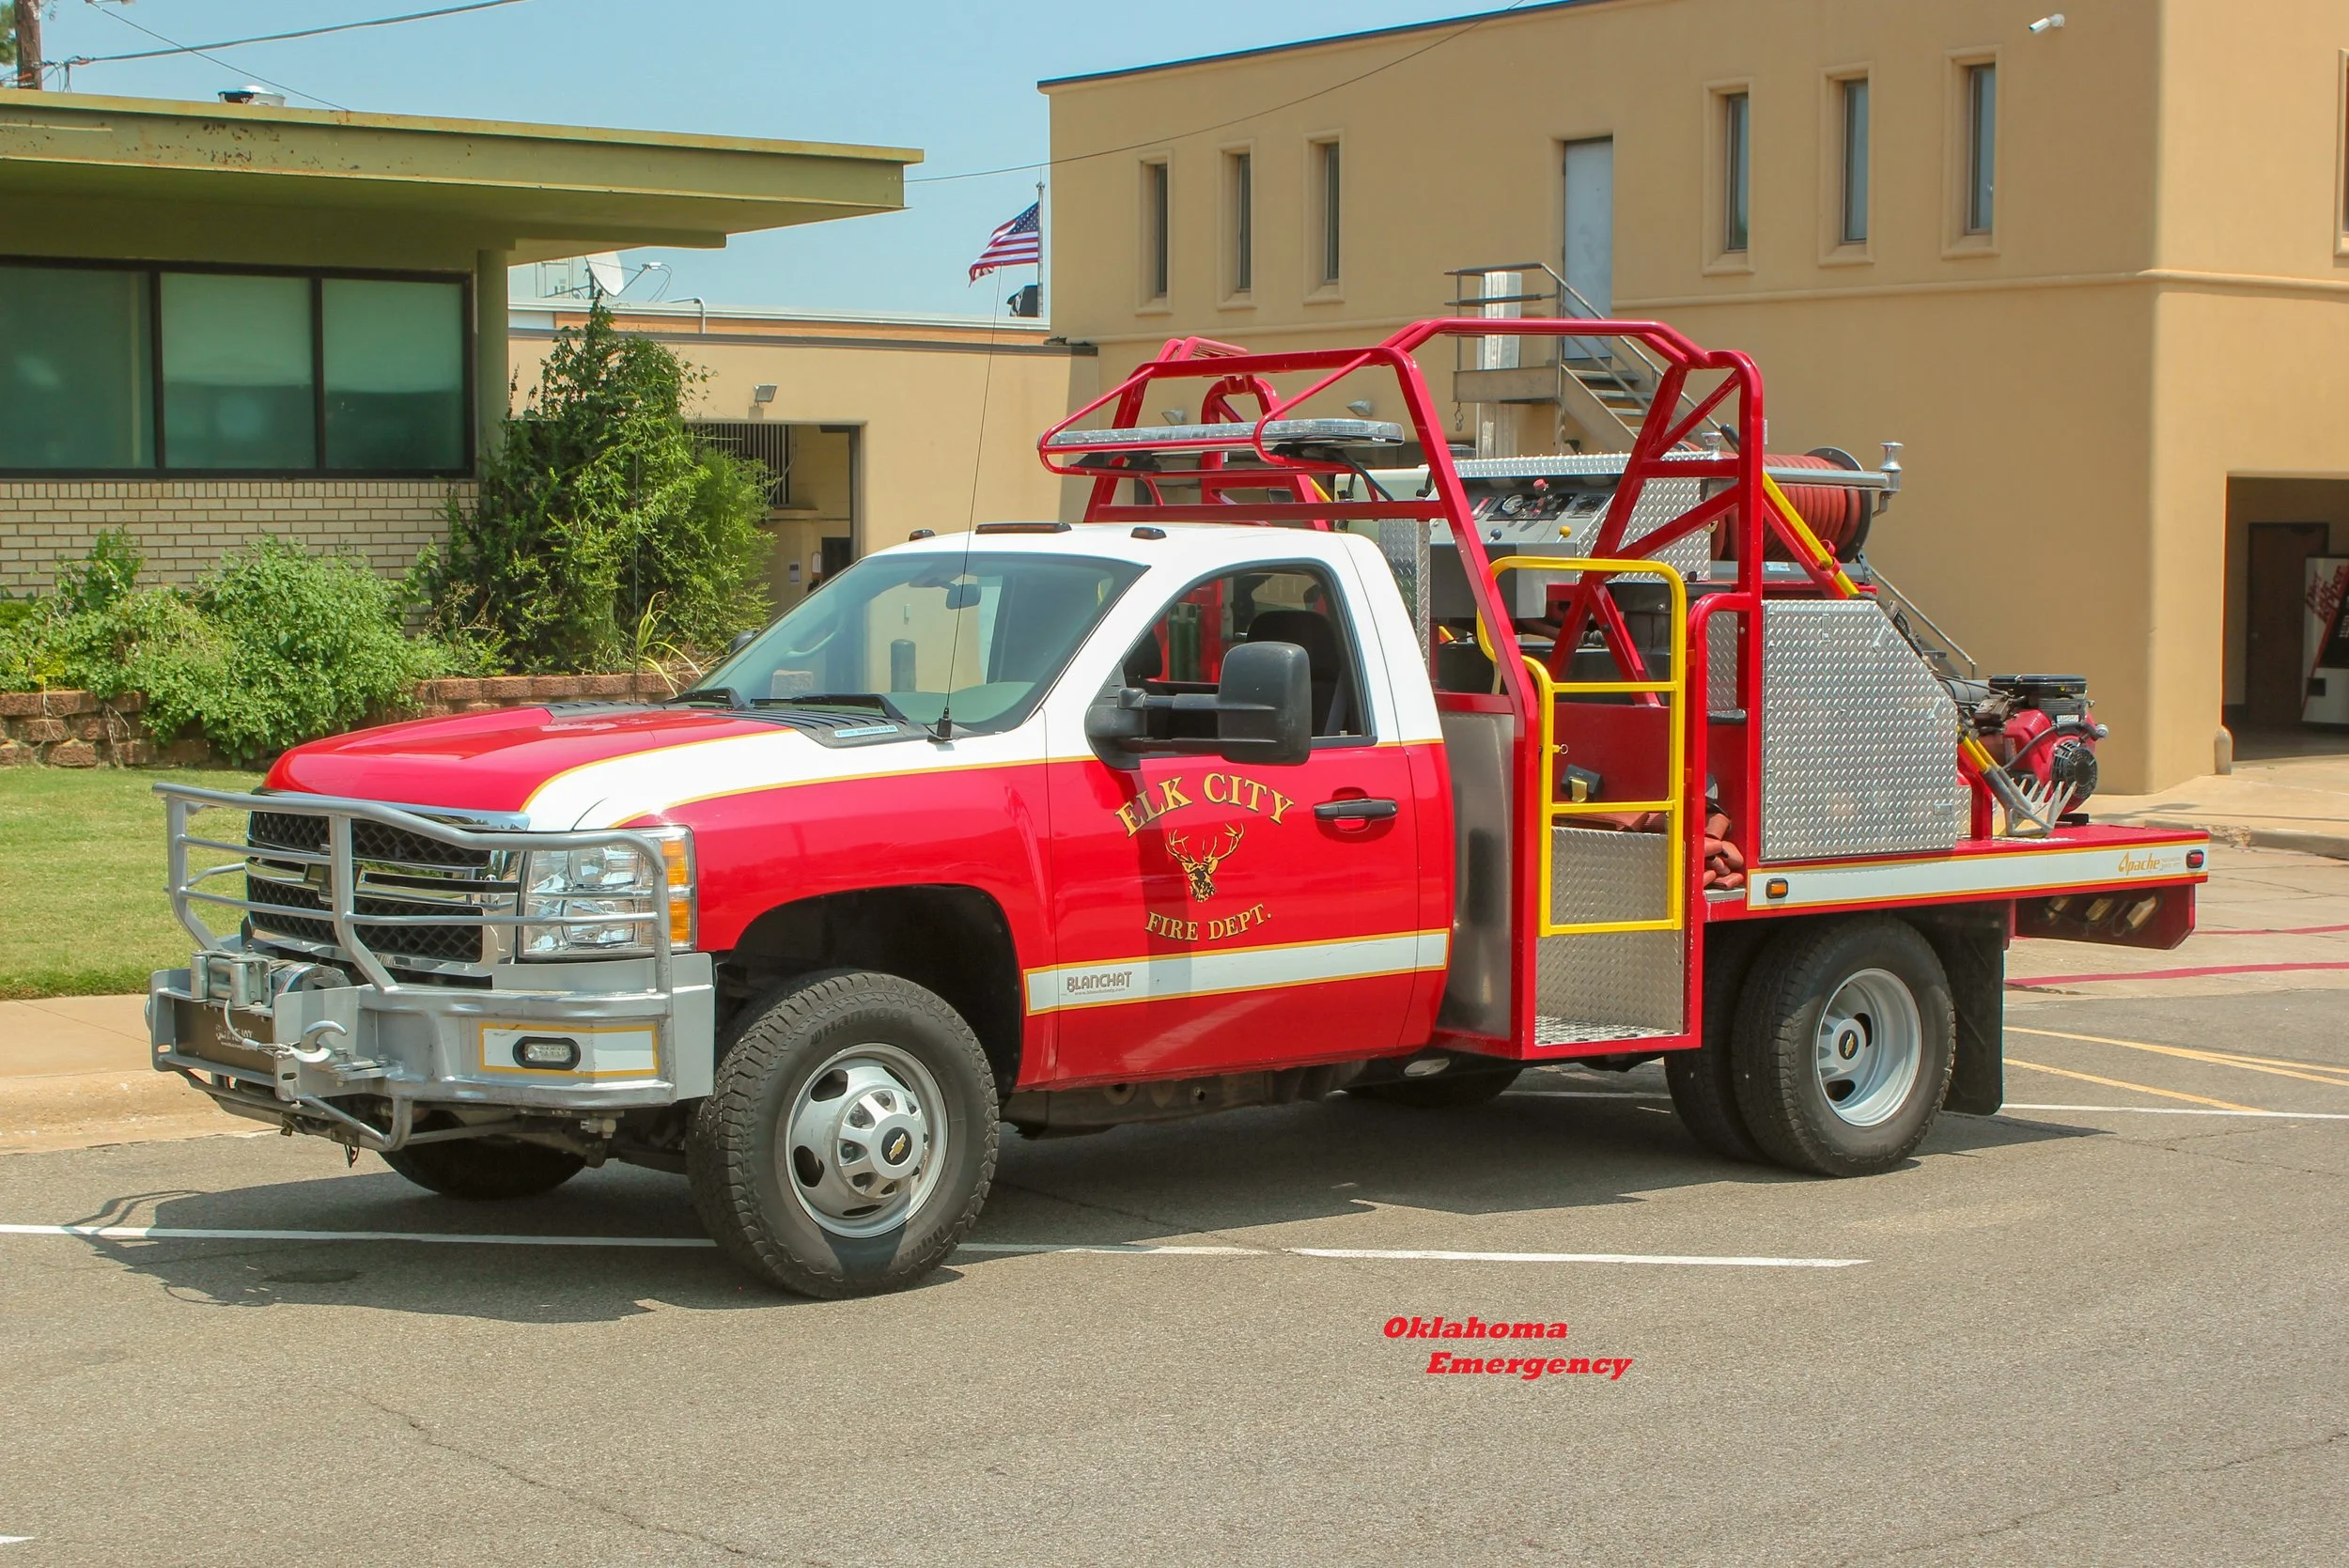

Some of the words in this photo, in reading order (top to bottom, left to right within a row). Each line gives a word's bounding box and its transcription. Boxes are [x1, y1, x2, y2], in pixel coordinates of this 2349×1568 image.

[1114, 776, 1193, 838] ELK
[1203, 772, 1295, 825] CITY
[2118, 850, 2161, 876] Apache
[1144, 911, 1199, 940] FIRE
[1208, 903, 1272, 940] DEPT.
[1066, 970, 1132, 992] BLANCHAT
